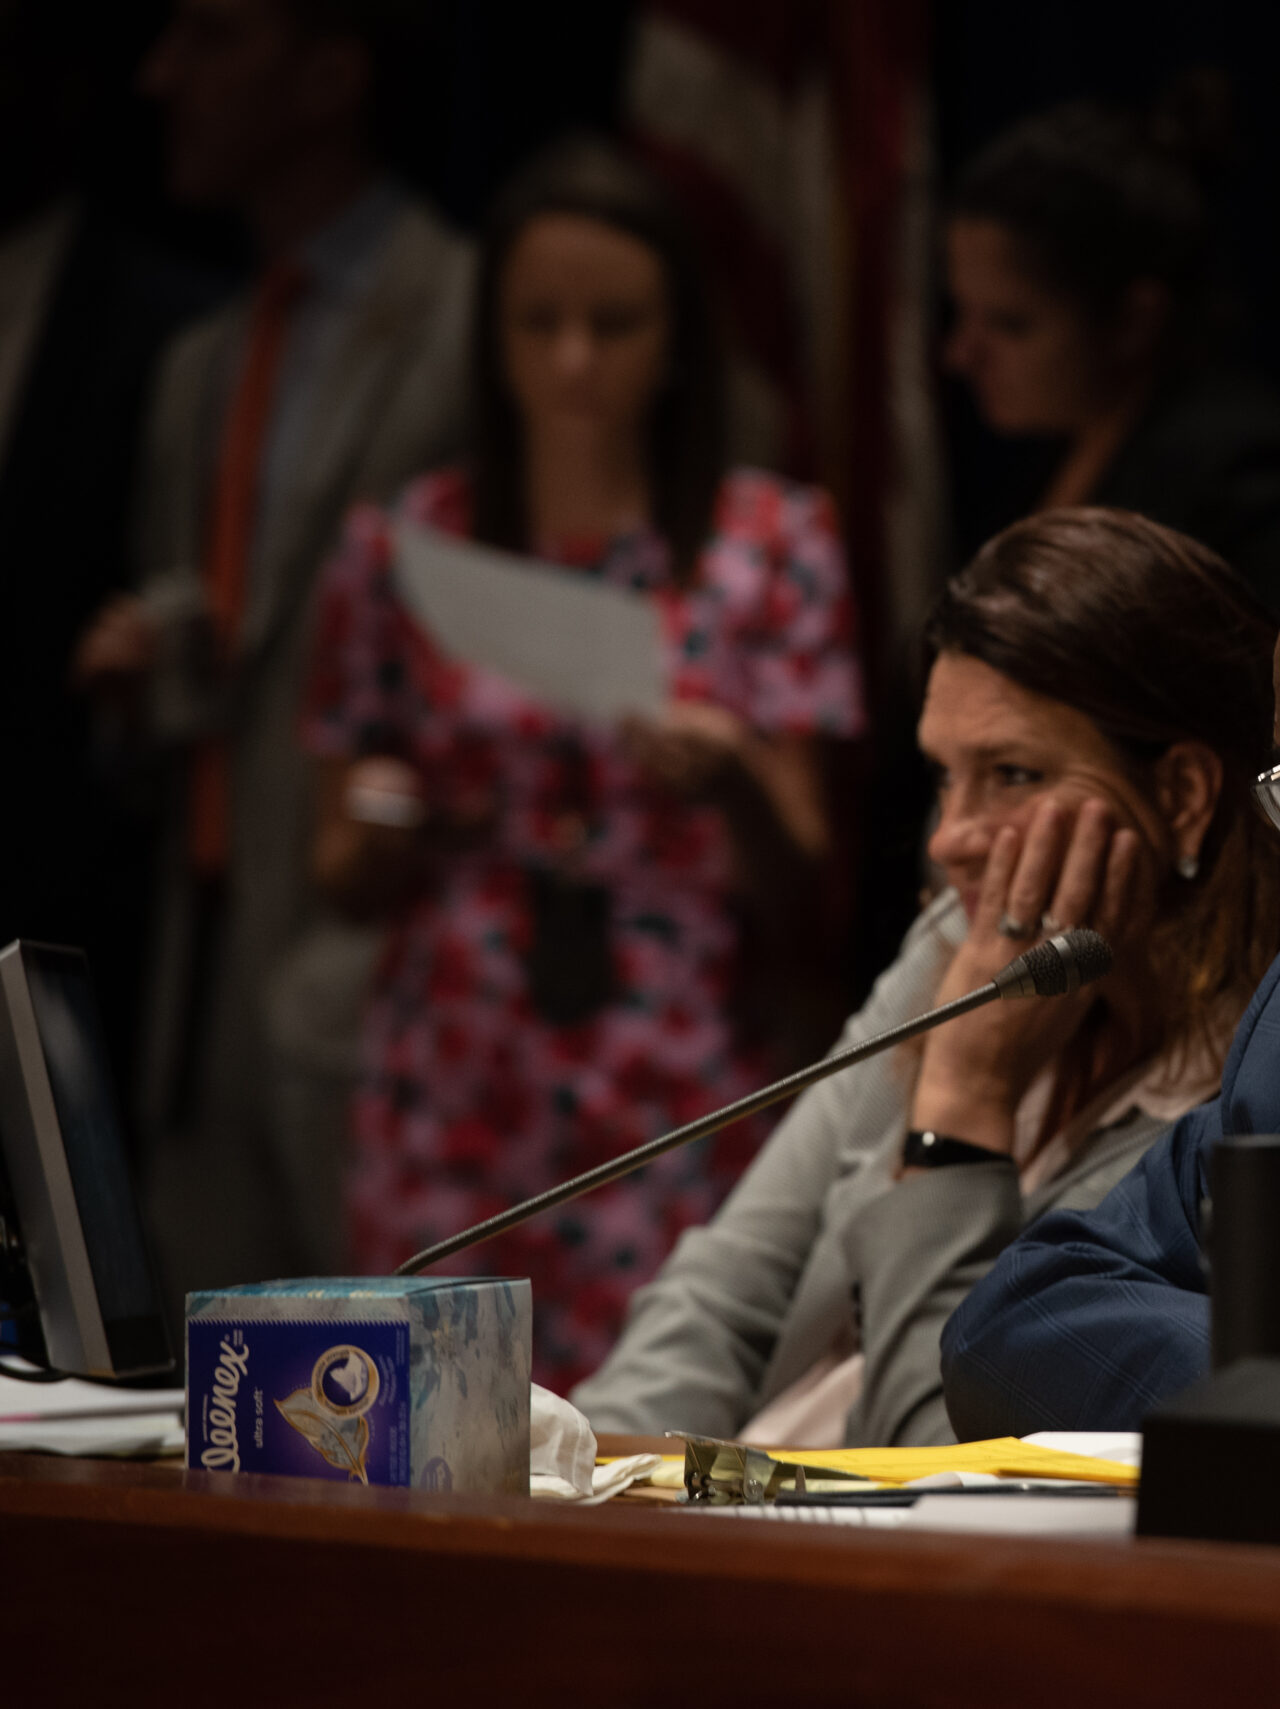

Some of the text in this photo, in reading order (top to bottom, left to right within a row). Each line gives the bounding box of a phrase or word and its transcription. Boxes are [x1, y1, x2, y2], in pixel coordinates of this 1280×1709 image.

[200, 1340, 250, 1474] leenex
[253, 1388, 264, 1449] ultra soft
